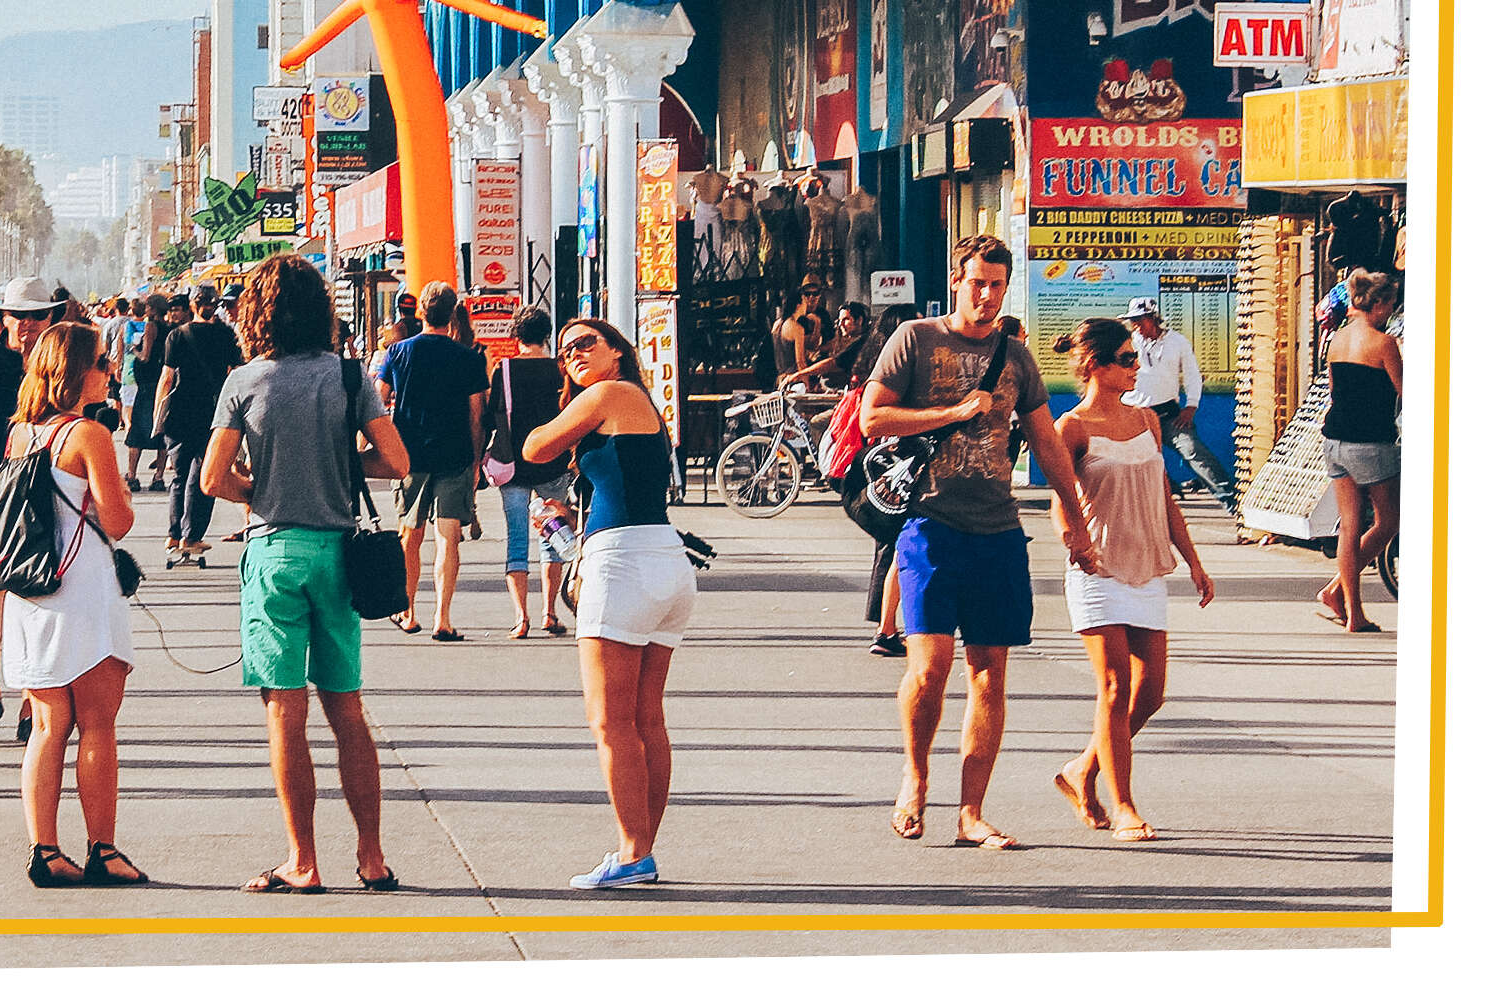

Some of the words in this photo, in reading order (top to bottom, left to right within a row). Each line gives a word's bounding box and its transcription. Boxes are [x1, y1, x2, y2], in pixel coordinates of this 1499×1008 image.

[1220, 18, 1304, 57] ATM
[1051, 126, 1198, 148] WROLDS
[1217, 126, 1241, 148] B
[1039, 158, 1187, 197] FUNNEL
[1036, 212, 1044, 224] 2
[1047, 211, 1068, 224] BIG
[1070, 211, 1106, 224] DADDY
[1110, 211, 1152, 224] CHEESE
[1154, 210, 1184, 224] PIZZA
[1196, 213, 1229, 224] MED
[1054, 232, 1060, 244] 2
[1066, 231, 1138, 244] PEPPERONI
[1154, 232, 1188, 244] MED
[1035, 248, 1078, 260] BIG
[1087, 248, 1166, 259] DADDY
[1193, 247, 1239, 259] SON
